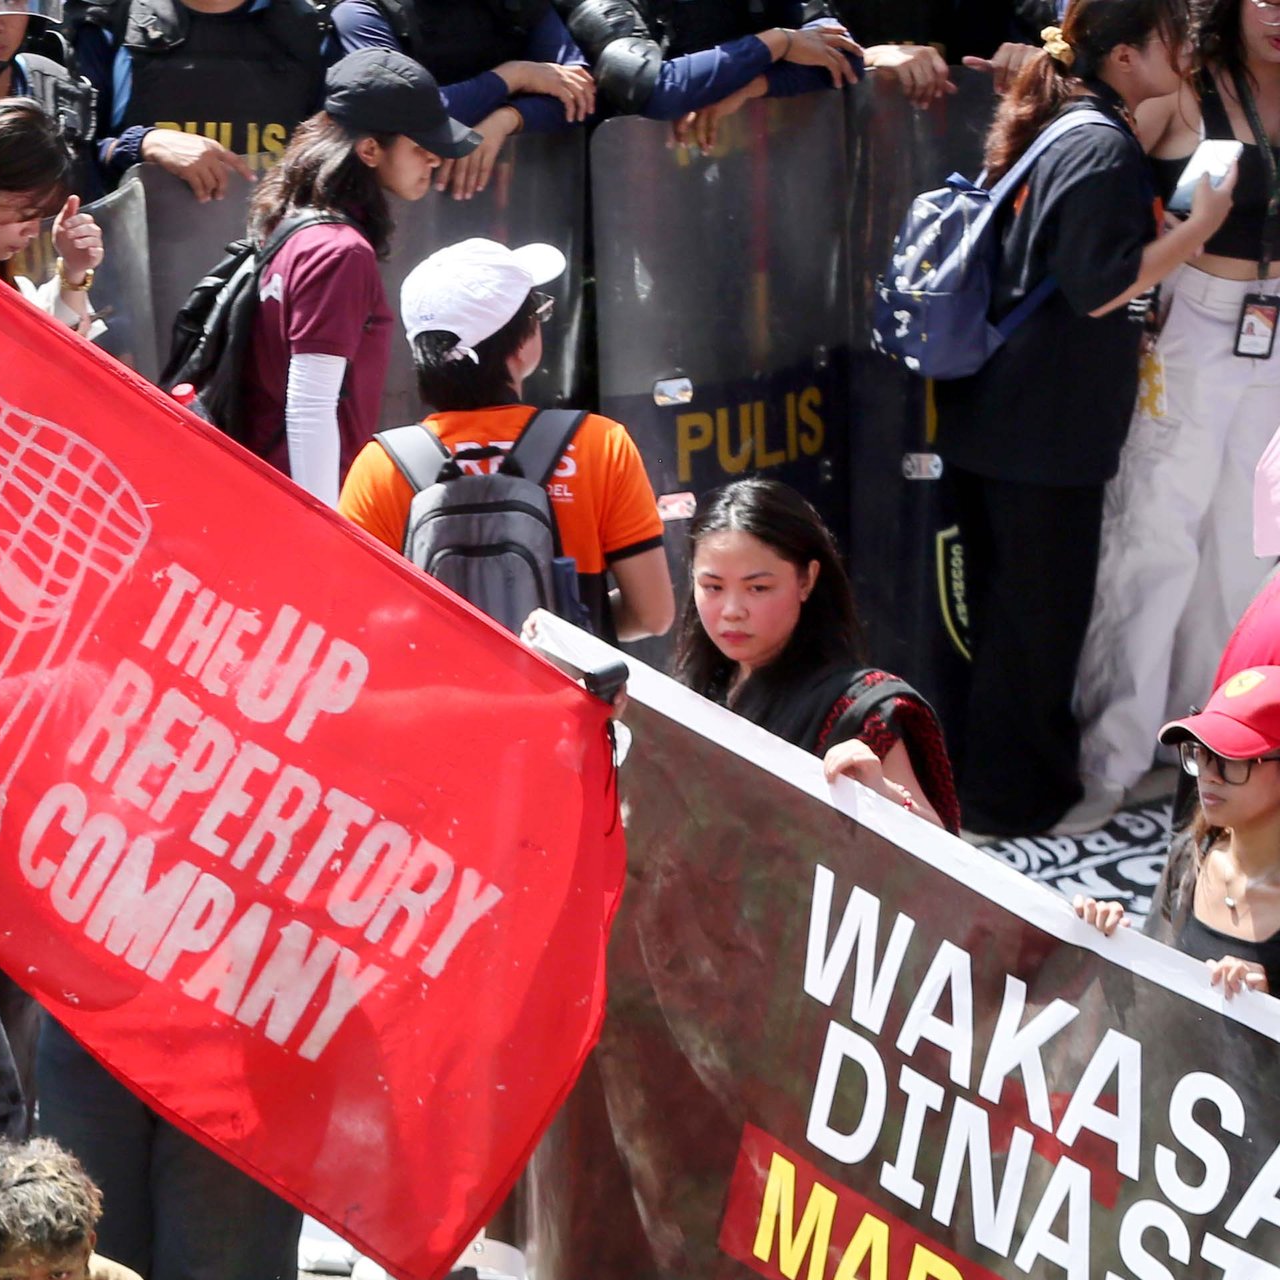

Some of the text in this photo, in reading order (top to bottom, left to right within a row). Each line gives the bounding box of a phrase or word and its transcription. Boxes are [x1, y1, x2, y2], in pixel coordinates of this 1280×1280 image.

[676, 386, 825, 482] PULIS
[140, 562, 370, 745] THE UP
[18, 782, 387, 1062] COMPANY
[68, 657, 503, 978] REPERTORY
